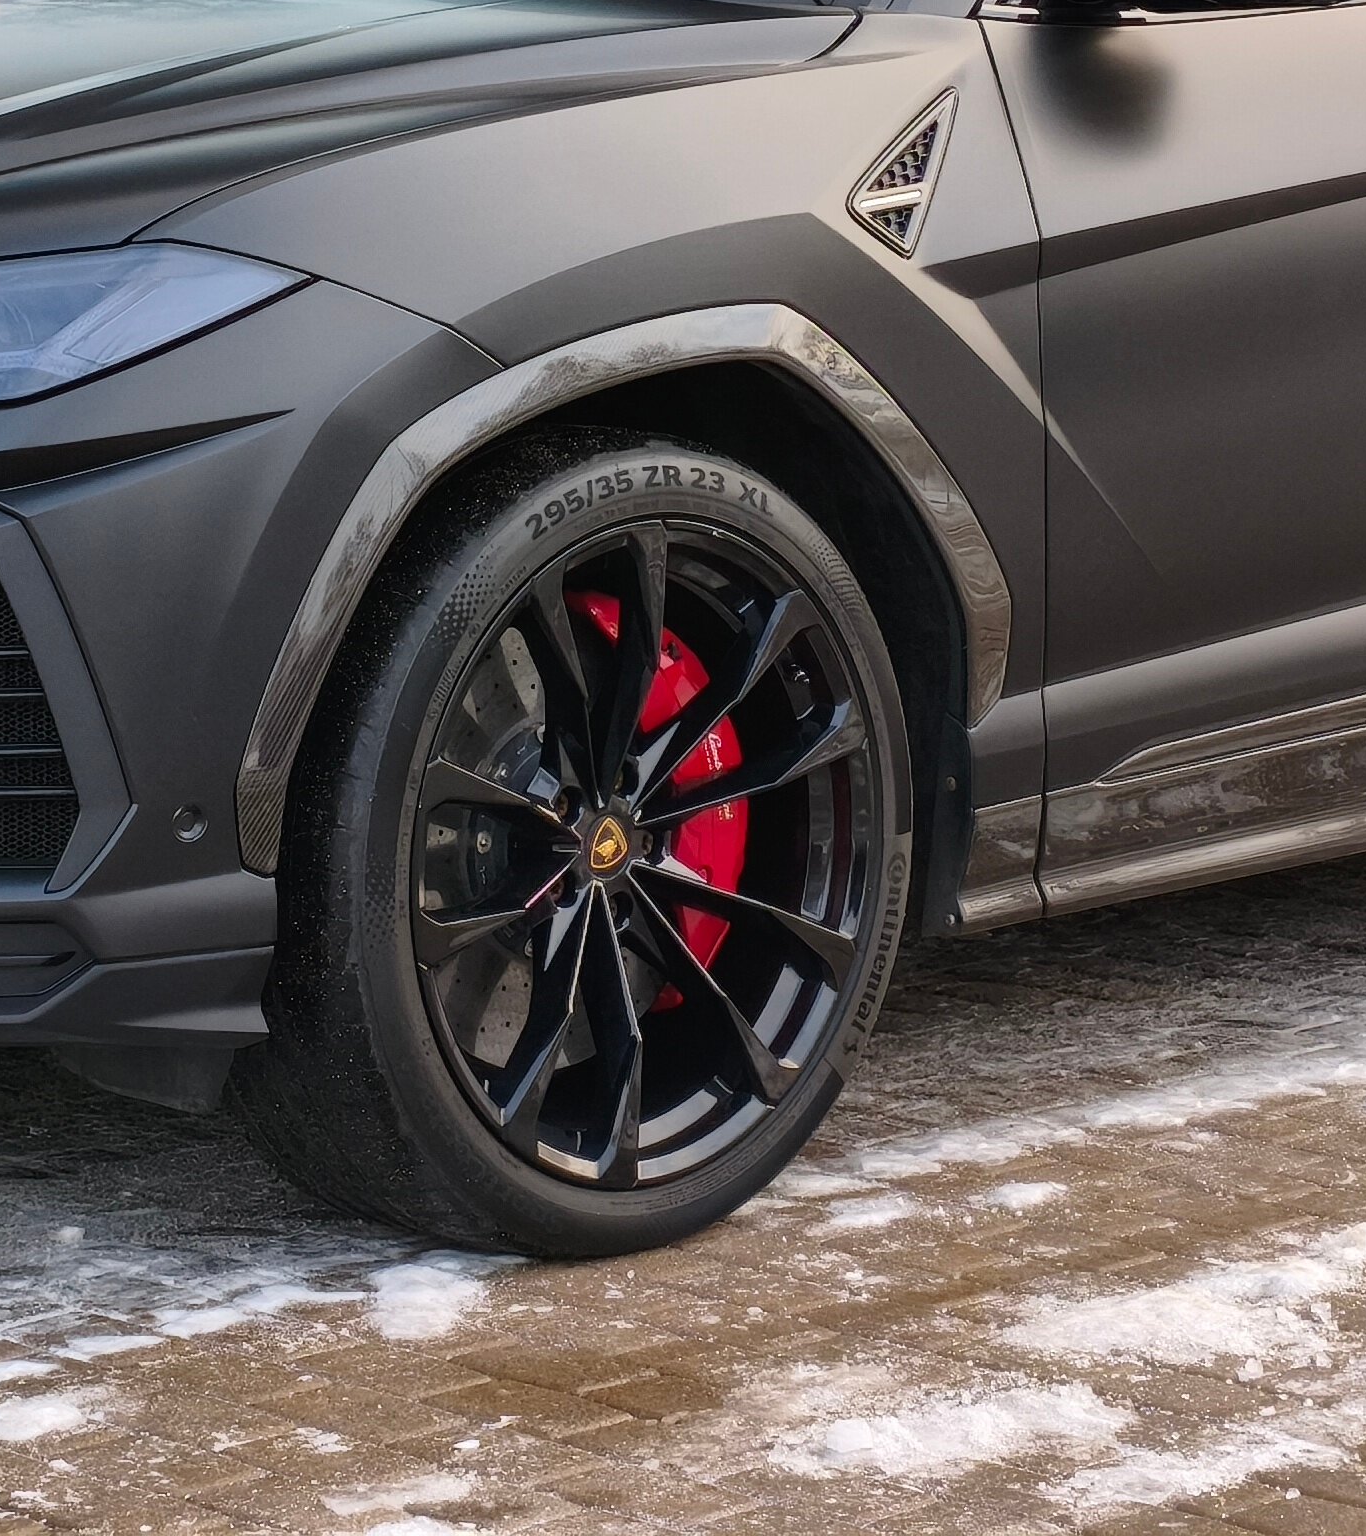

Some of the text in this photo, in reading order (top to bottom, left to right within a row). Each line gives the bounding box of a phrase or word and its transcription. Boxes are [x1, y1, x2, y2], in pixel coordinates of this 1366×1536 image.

[524, 469, 634, 541] 295/35
[641, 464, 684, 489] ZR
[690, 467, 727, 494] 23
[737, 480, 774, 517] XL
[850, 851, 907, 1033] Continental
